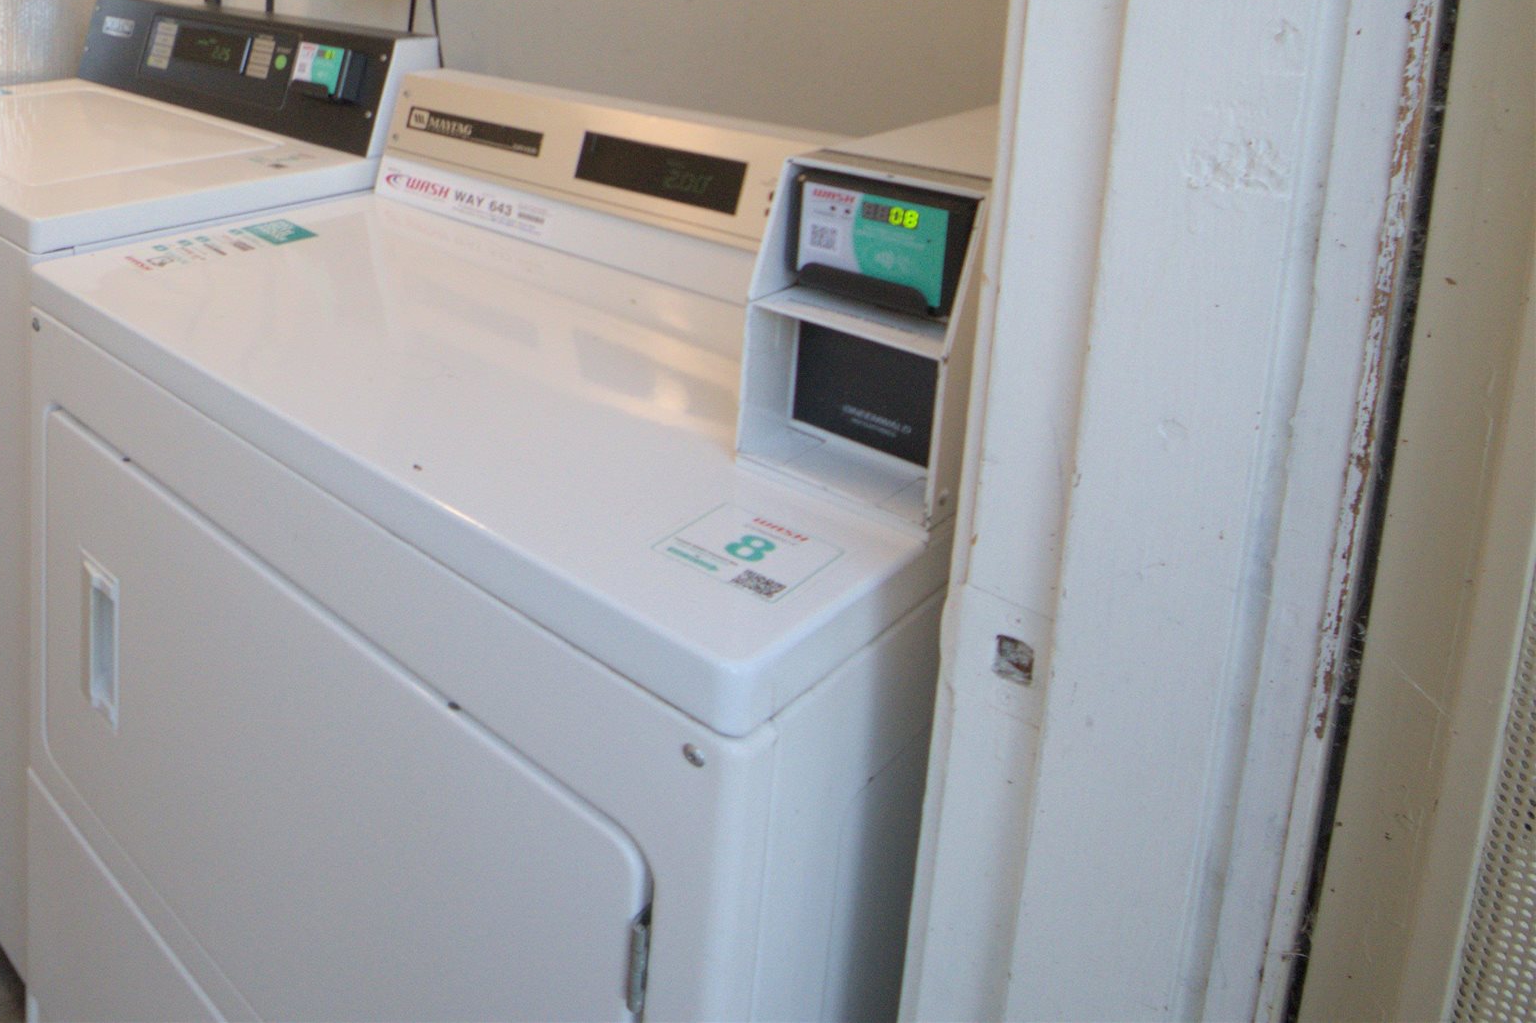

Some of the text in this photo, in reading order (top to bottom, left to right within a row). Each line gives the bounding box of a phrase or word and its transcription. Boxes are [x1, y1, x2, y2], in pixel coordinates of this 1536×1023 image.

[428, 115, 473, 137] MAYTAG
[407, 177, 452, 199] WASH
[454, 189, 485, 208] WAY
[489, 200, 513, 217] 643
[888, 206, 920, 230] 08
[724, 534, 777, 563] 8
